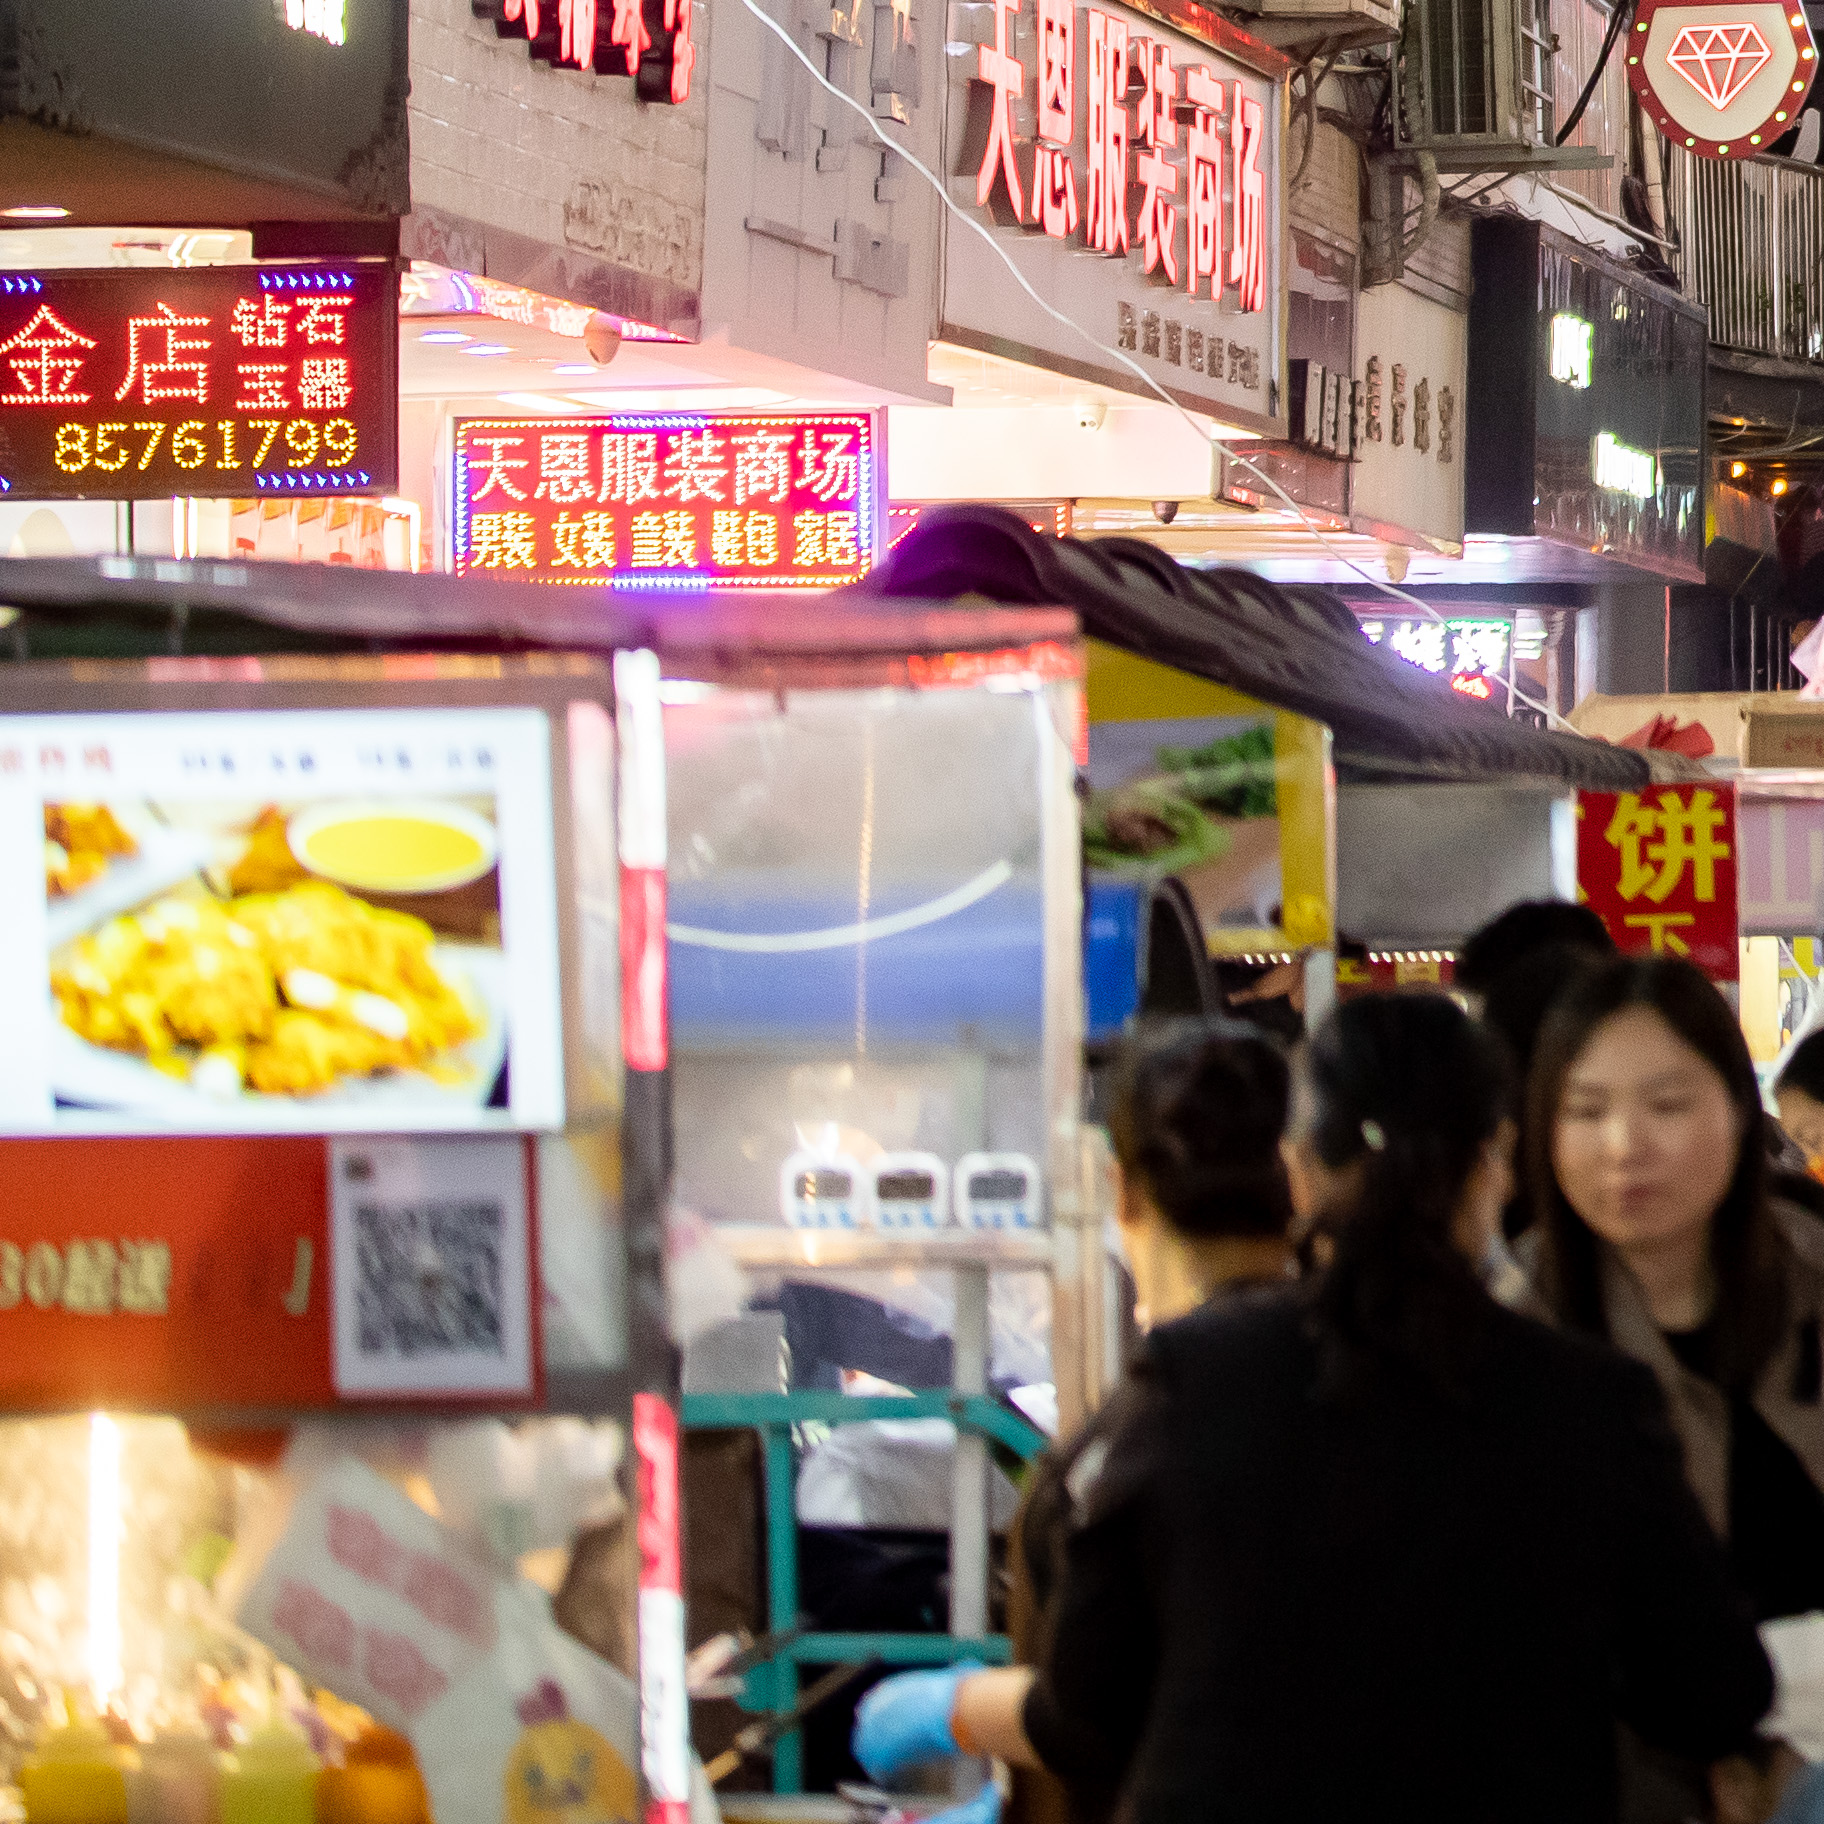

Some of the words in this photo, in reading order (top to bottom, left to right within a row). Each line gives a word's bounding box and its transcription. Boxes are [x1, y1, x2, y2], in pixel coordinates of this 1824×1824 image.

[0, 301, 213, 405] 金店
[231, 293, 354, 348] 钻石
[55, 417, 358, 473] 85761799
[466, 429, 859, 506] 天恩服装商场
[1576, 789, 1731, 905] 饼
